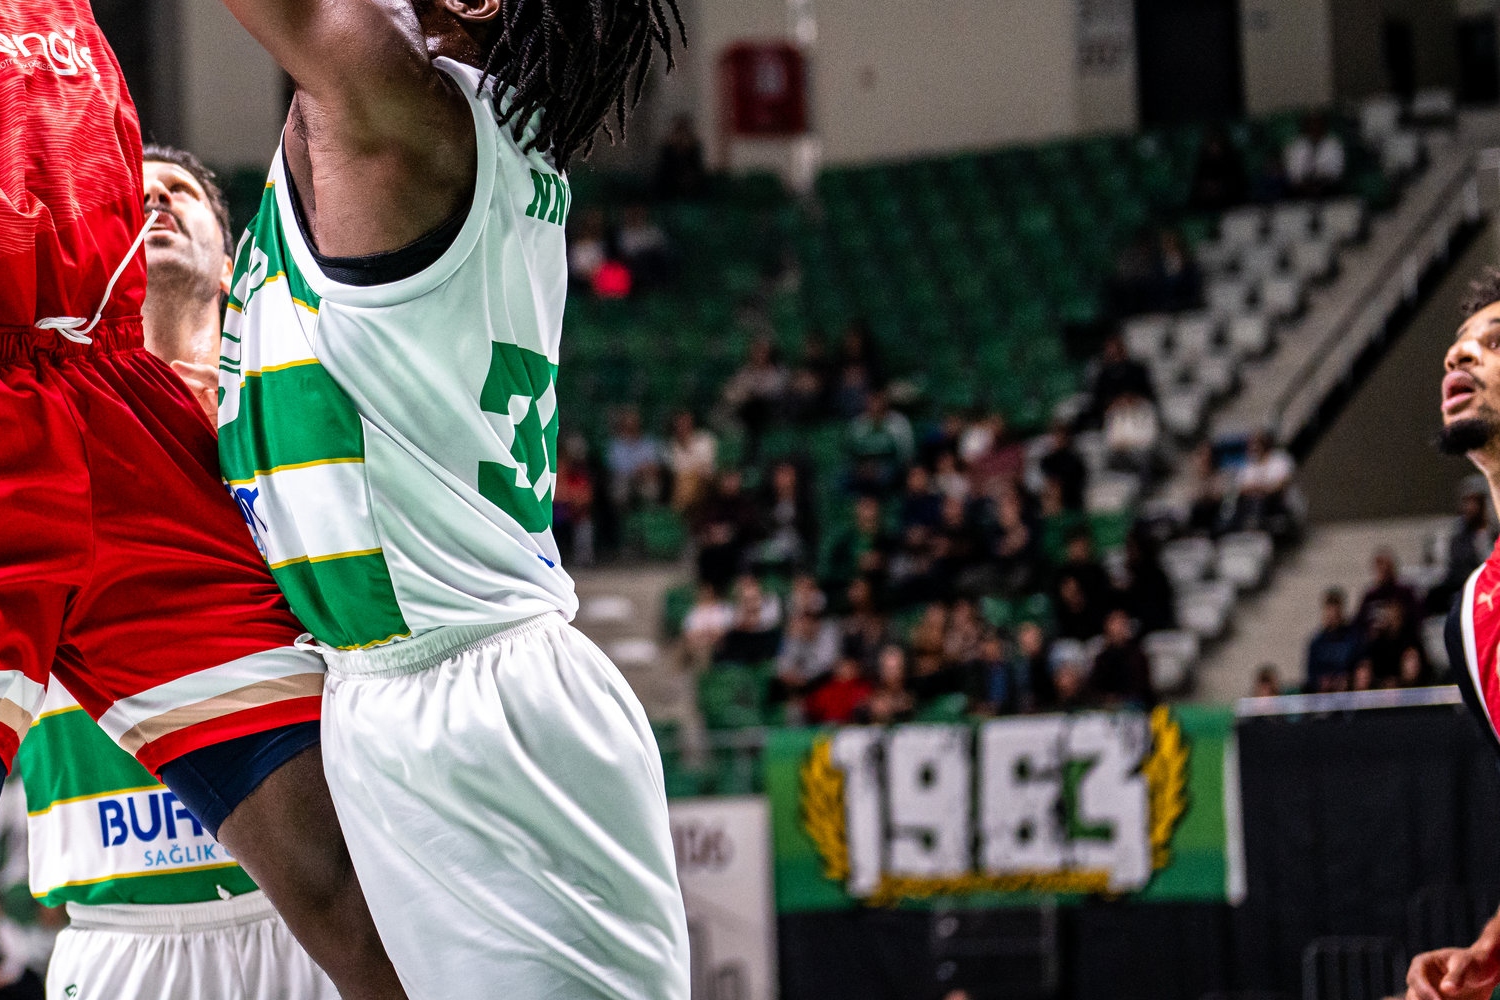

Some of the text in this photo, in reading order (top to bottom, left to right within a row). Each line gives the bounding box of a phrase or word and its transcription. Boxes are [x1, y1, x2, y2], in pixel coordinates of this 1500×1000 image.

[98, 791, 204, 848] BUR
[830, 714, 1153, 897] 1963
[145, 843, 216, 867] SAĞLIK
